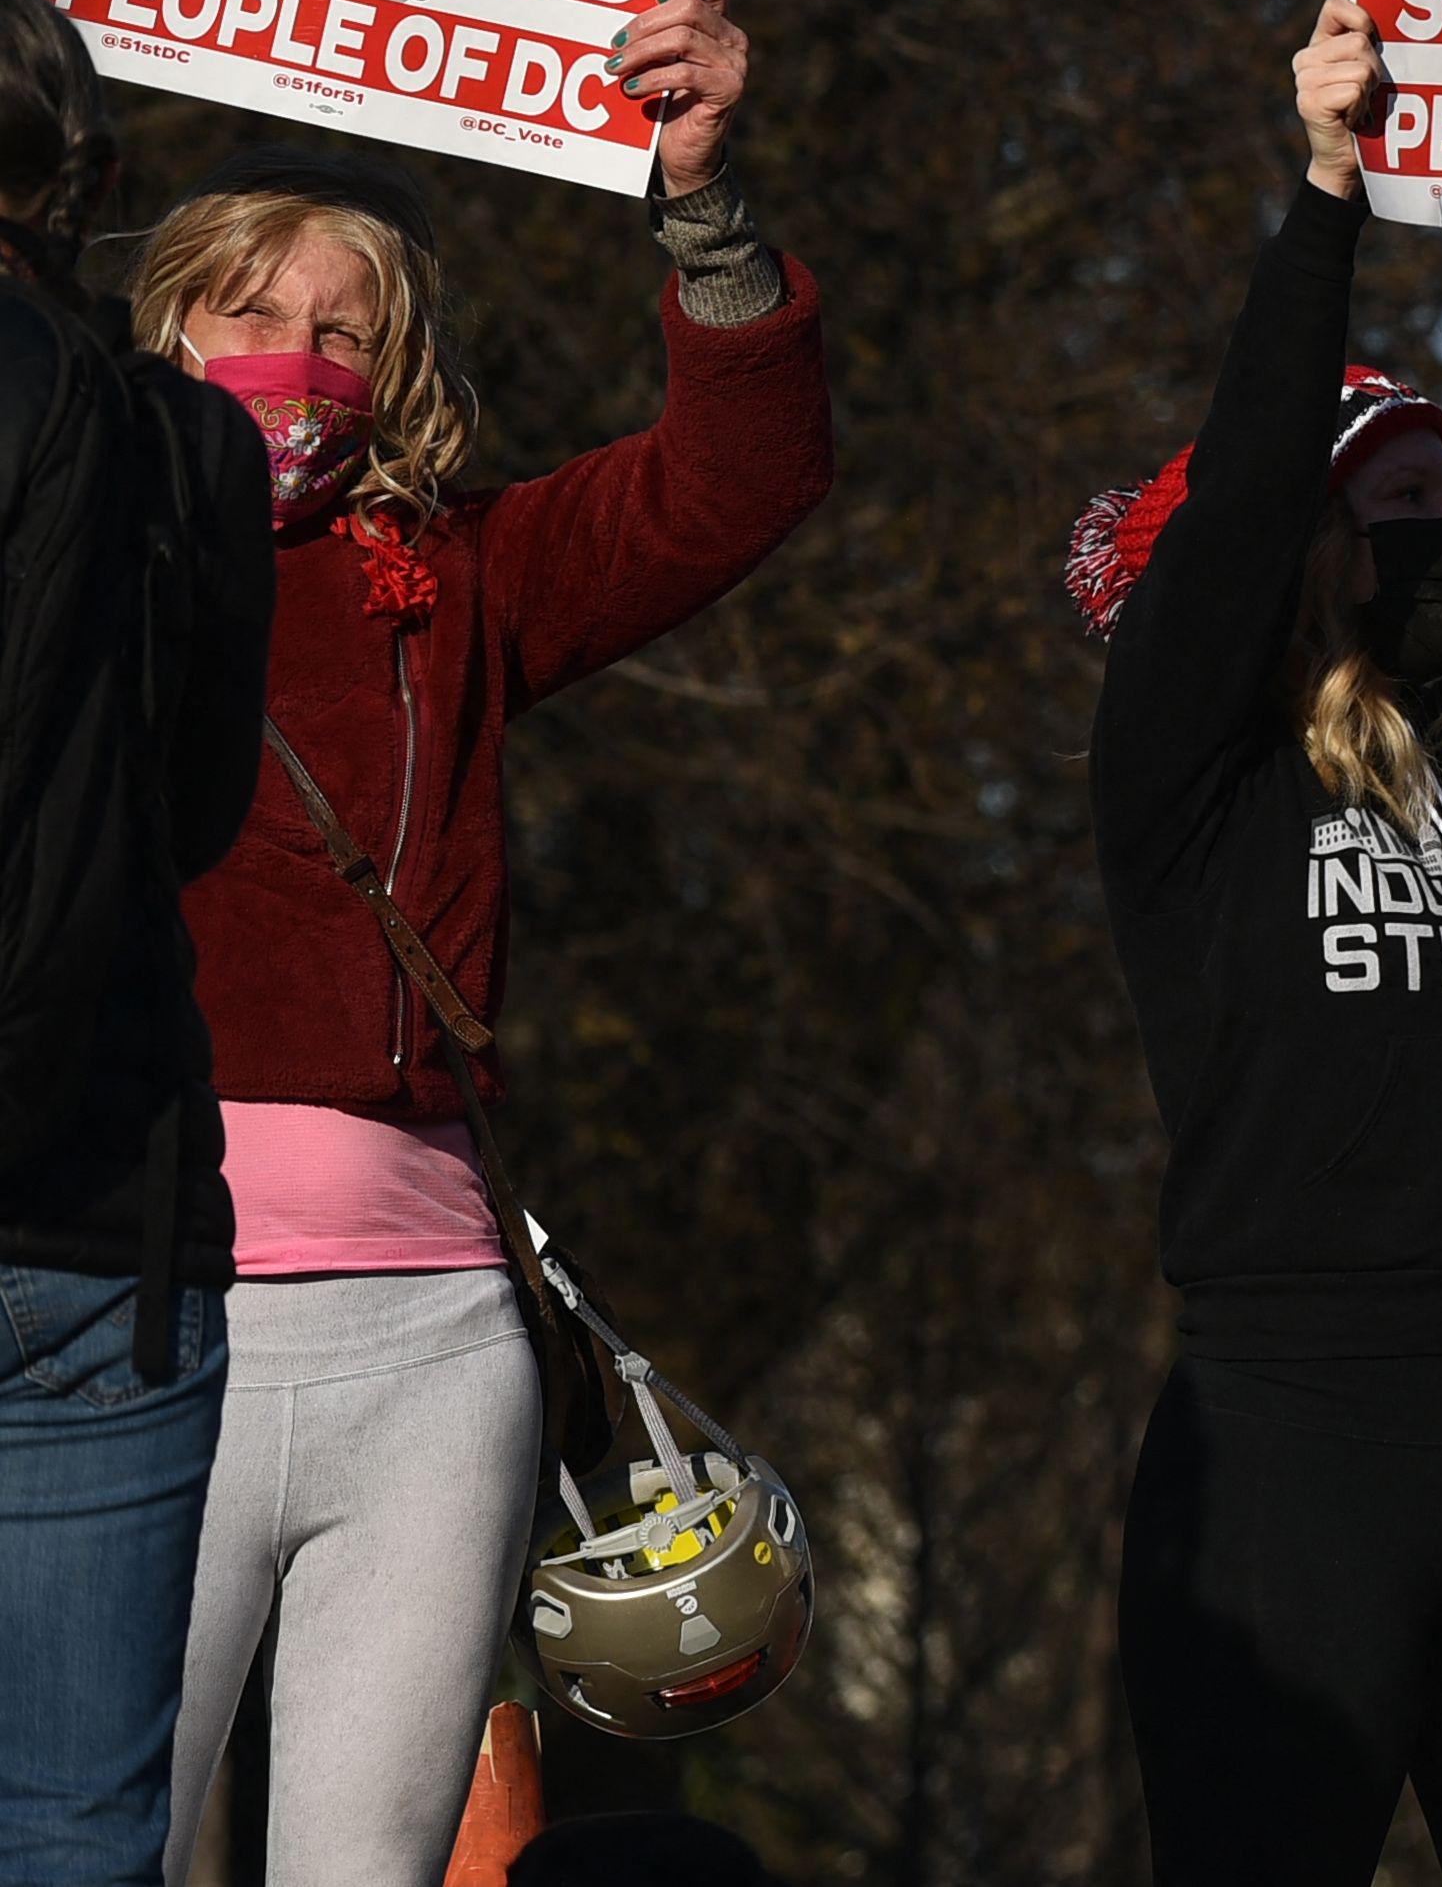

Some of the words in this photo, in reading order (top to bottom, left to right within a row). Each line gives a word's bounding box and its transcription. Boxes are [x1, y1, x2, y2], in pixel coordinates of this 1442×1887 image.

[100, 33, 191, 64] @51stDC
[273, 73, 364, 106] @51for51
[459, 116, 564, 149] @DC_Vote
[383, 16, 500, 101] OF
[502, 39, 620, 132] DC
